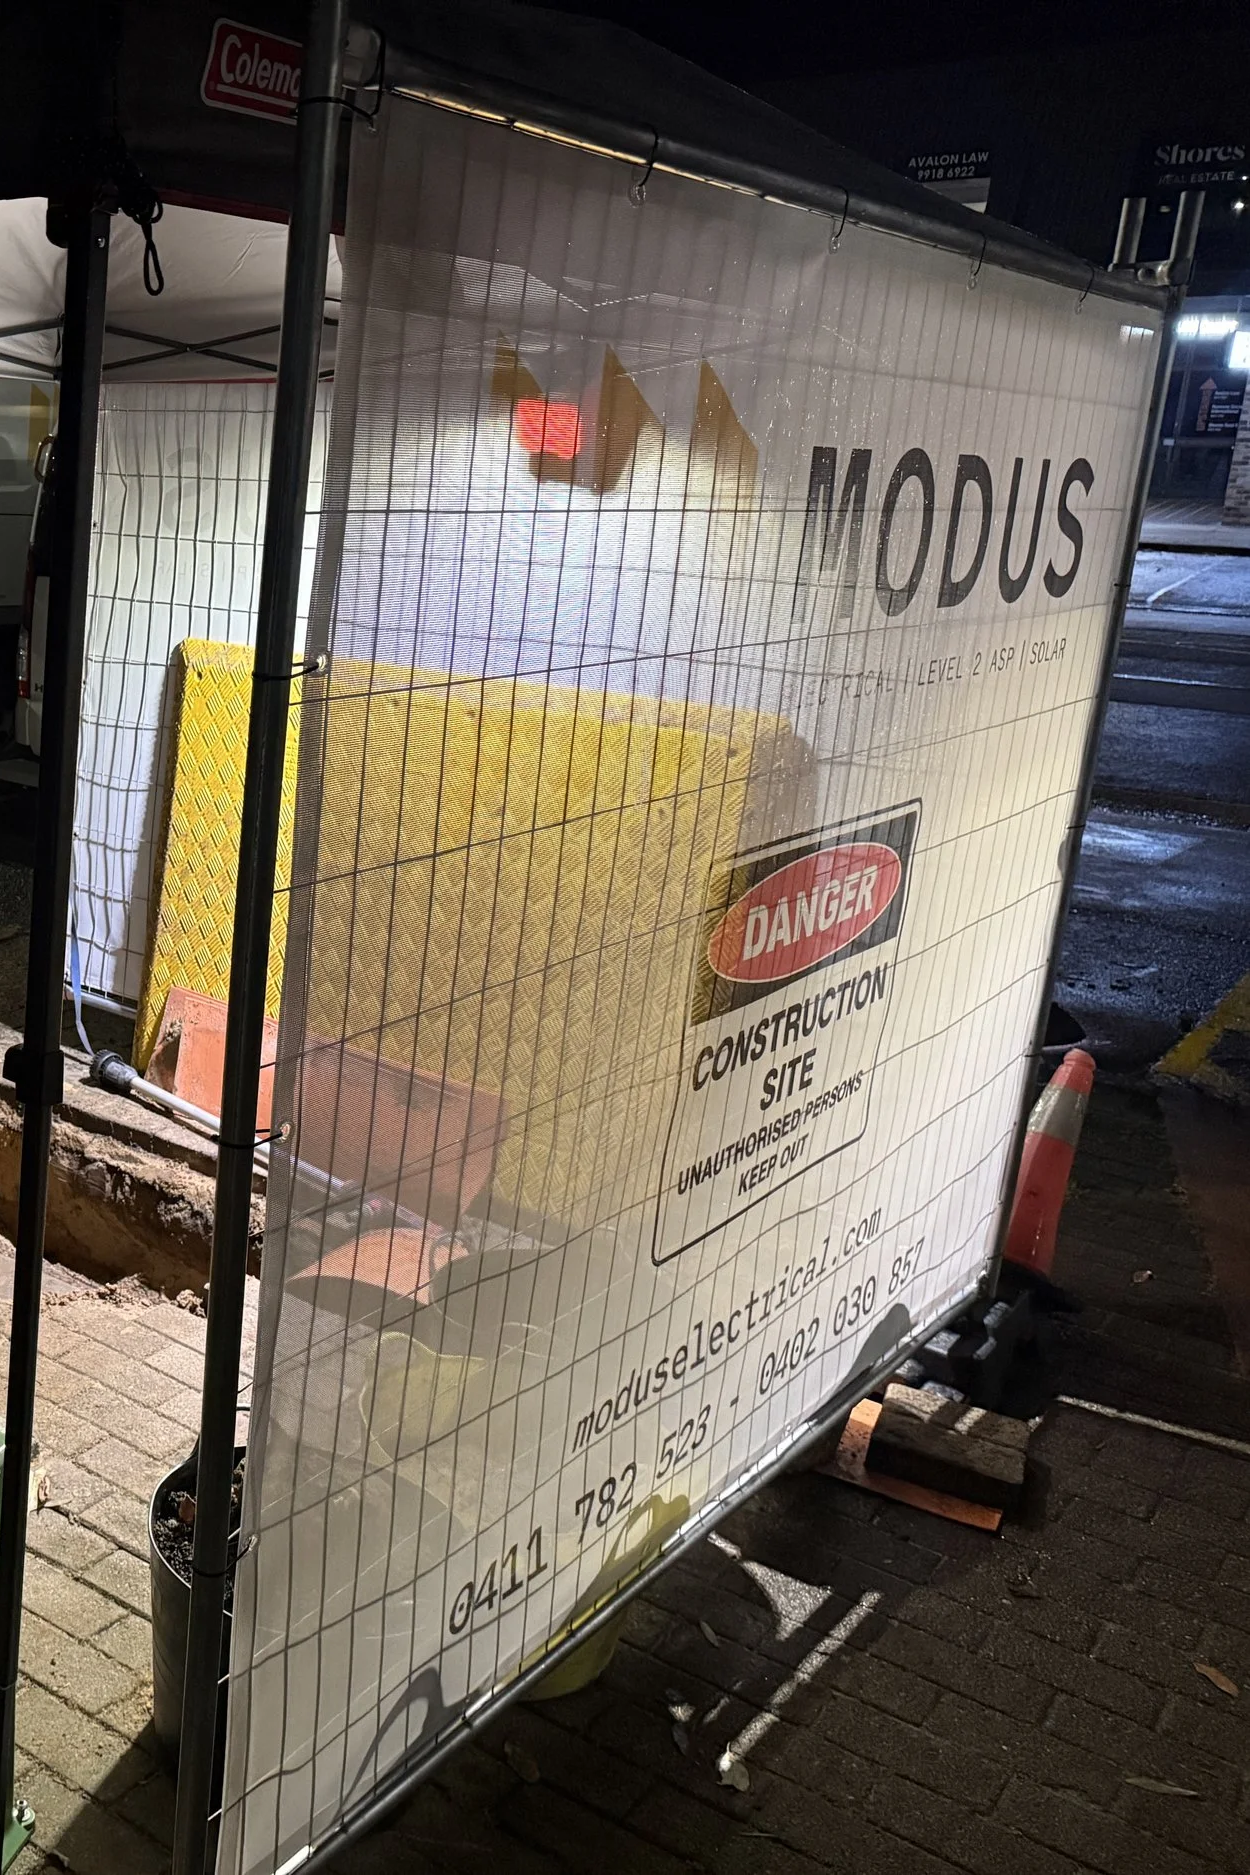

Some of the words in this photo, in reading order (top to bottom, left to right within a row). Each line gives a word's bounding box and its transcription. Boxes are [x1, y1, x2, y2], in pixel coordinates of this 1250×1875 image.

[221, 34, 302, 98] Colema
[908, 153, 960, 168] AVALON
[962, 151, 990, 165] LAW
[917, 167, 945, 181] 9918
[946, 165, 976, 179] 6922
[1153, 144, 1246, 167] Shores
[1190, 170, 1236, 184] ESTATE
[790, 446, 1095, 624] MODUS
[918, 655, 962, 686] LEVEL
[972, 652, 983, 676] 2
[989, 647, 1015, 673] ASP
[1030, 638, 1067, 665] SOLAR
[742, 865, 879, 962] DANGER
[692, 962, 889, 1092] CONSTRUCTION
[760, 1048, 816, 1111] SITE
[677, 1107, 803, 1196] UNAUTHORISED
[802, 1070, 864, 1124] PERSONS
[737, 1153, 778, 1197] KEEP
[779, 1133, 810, 1177] OUT
[572, 1206, 883, 1454] moduselectrical.com
[448, 1525, 549, 1636] 0411
[574, 1461, 638, 1544] 782
[656, 1403, 714, 1482] 523
[758, 1317, 822, 1396] 0402
[832, 1275, 877, 1337] 030
[888, 1236, 926, 1298] 857
